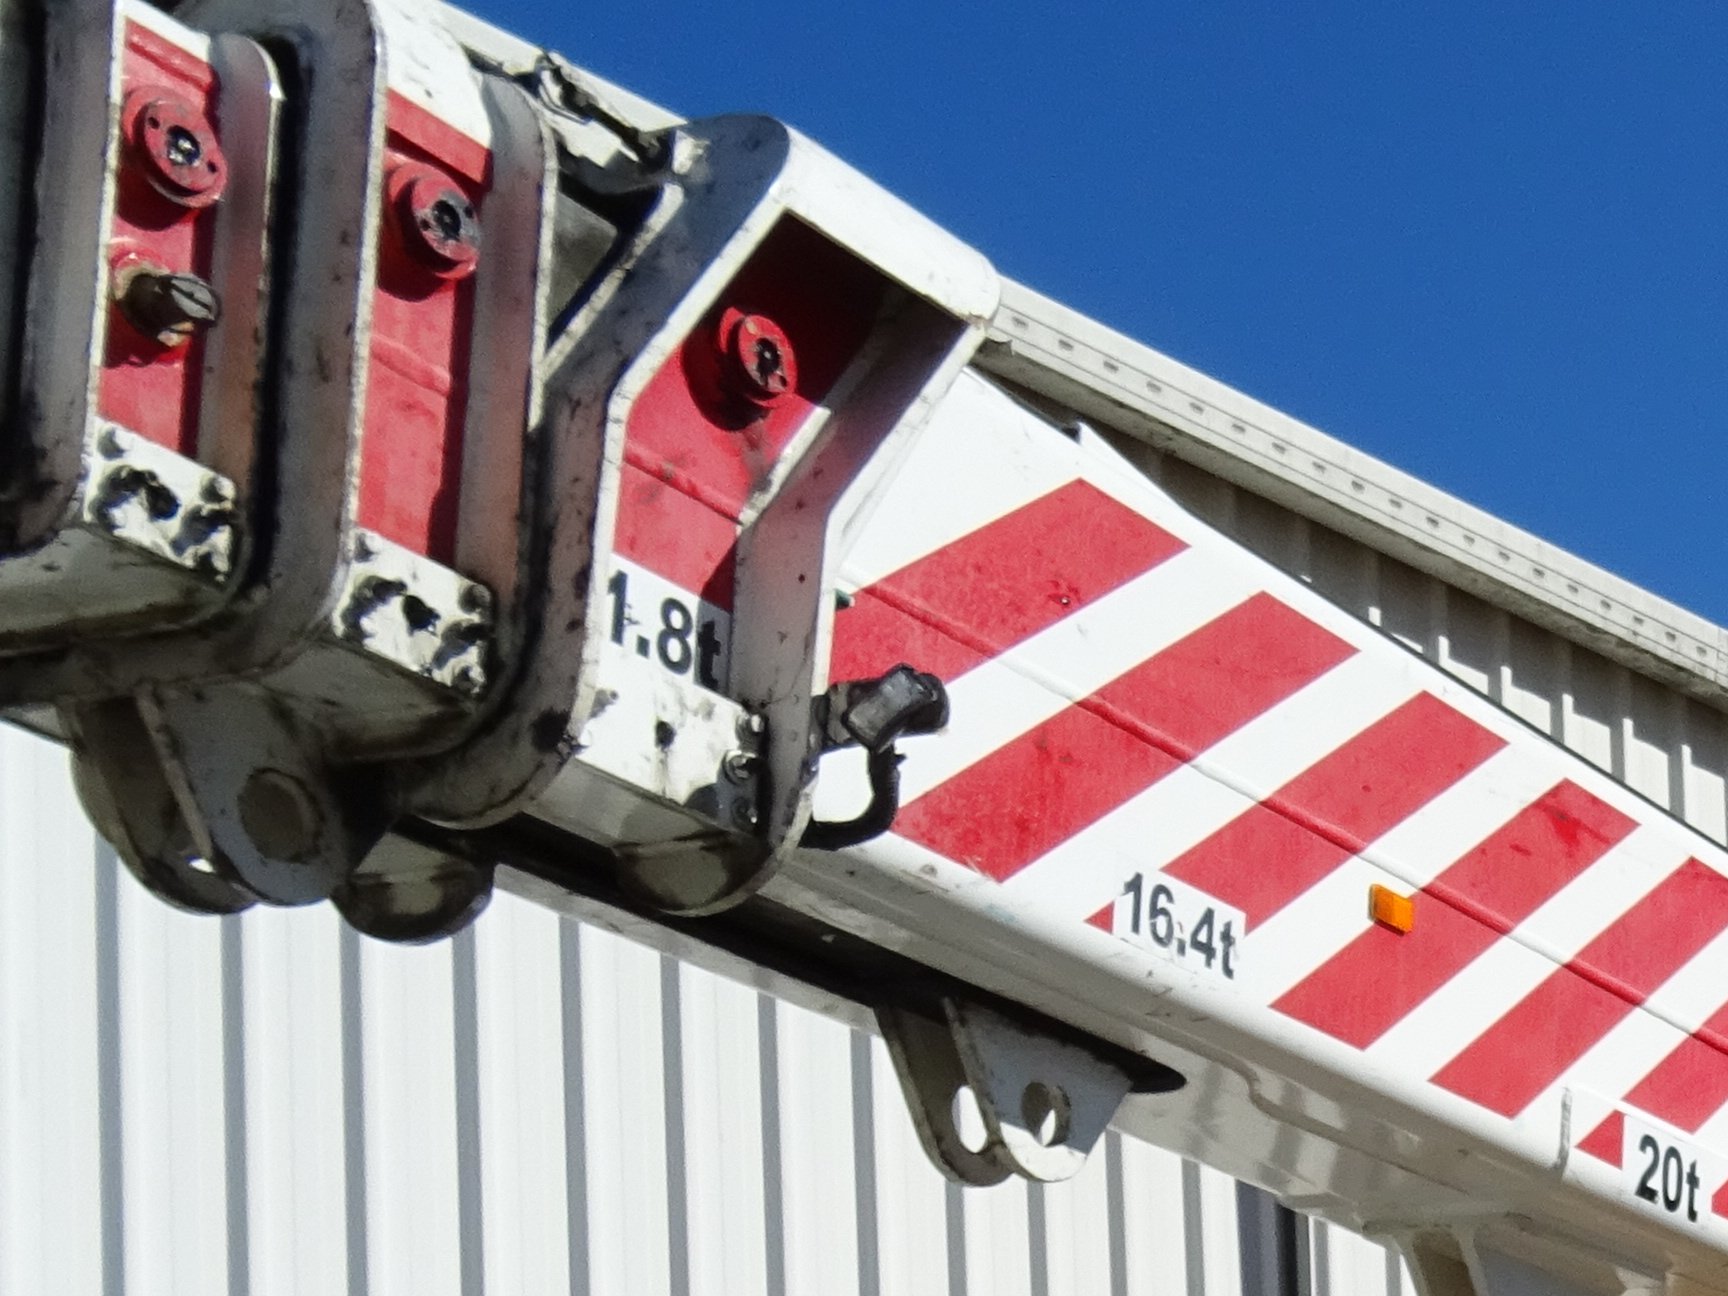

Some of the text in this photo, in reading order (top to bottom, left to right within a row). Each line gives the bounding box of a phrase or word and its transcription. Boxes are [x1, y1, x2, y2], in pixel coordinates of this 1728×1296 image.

[606, 570, 724, 689] 1.8t
[1122, 872, 1237, 980] 16.4t
[1634, 1134, 1701, 1222] 20t
